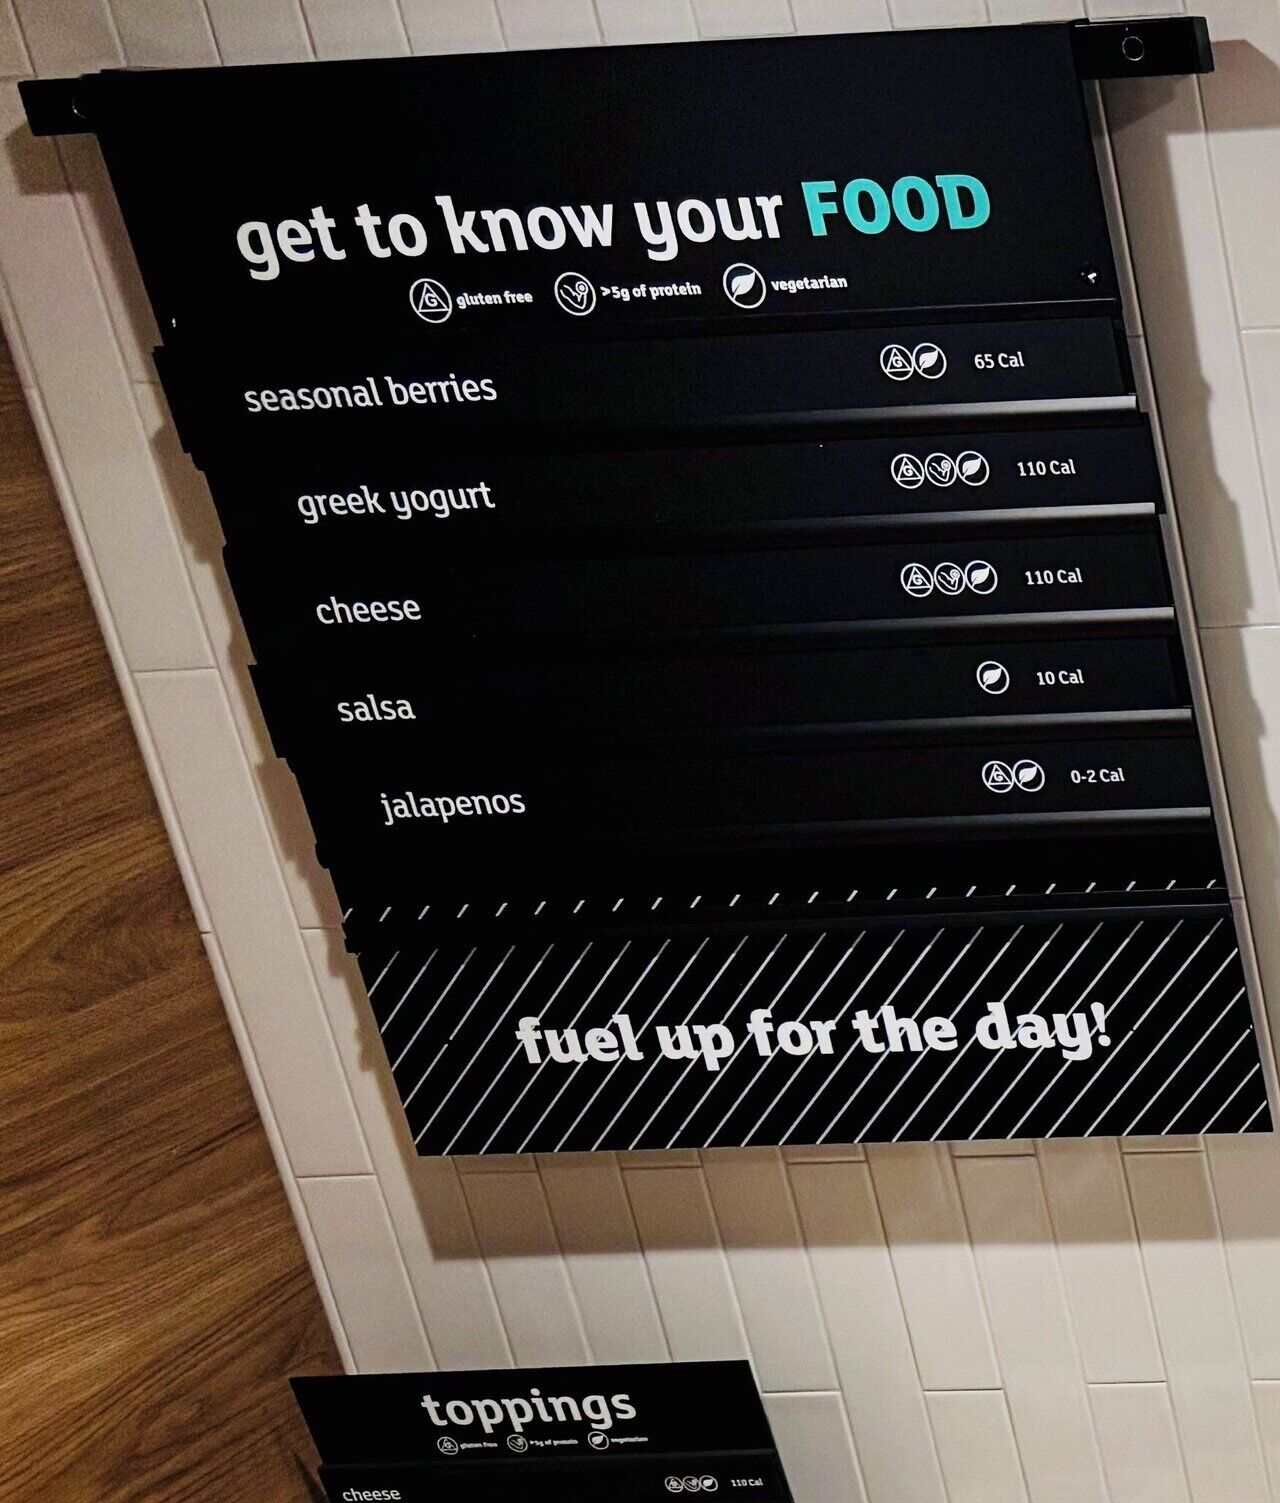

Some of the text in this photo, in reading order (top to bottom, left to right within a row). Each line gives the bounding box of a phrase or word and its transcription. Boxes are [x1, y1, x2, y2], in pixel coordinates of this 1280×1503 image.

[236, 174, 991, 281] get to know your FOOD
[599, 281, 702, 302] >5g of protein
[770, 274, 848, 294] vegetarian
[455, 290, 534, 310] gluten free
[974, 351, 1025, 370] 65 Cal
[244, 373, 498, 413] seasonal berries
[1017, 458, 1076, 477] 110 Cal
[297, 481, 496, 525] greek yogurt
[1024, 567, 1083, 585] 110 Cal
[316, 596, 422, 625] cheese
[1036, 668, 1085, 686] 10 Cal
[337, 693, 417, 722] salsa
[1070, 767, 1125, 784] 0-2 Cal
[380, 791, 526, 826] jalapenos
[514, 1000, 1113, 1071] fuel up for the day!
[420, 1387, 637, 1433] toppings
[730, 1477, 764, 1487] 110 Cal
[342, 1487, 402, 1502] cheese
